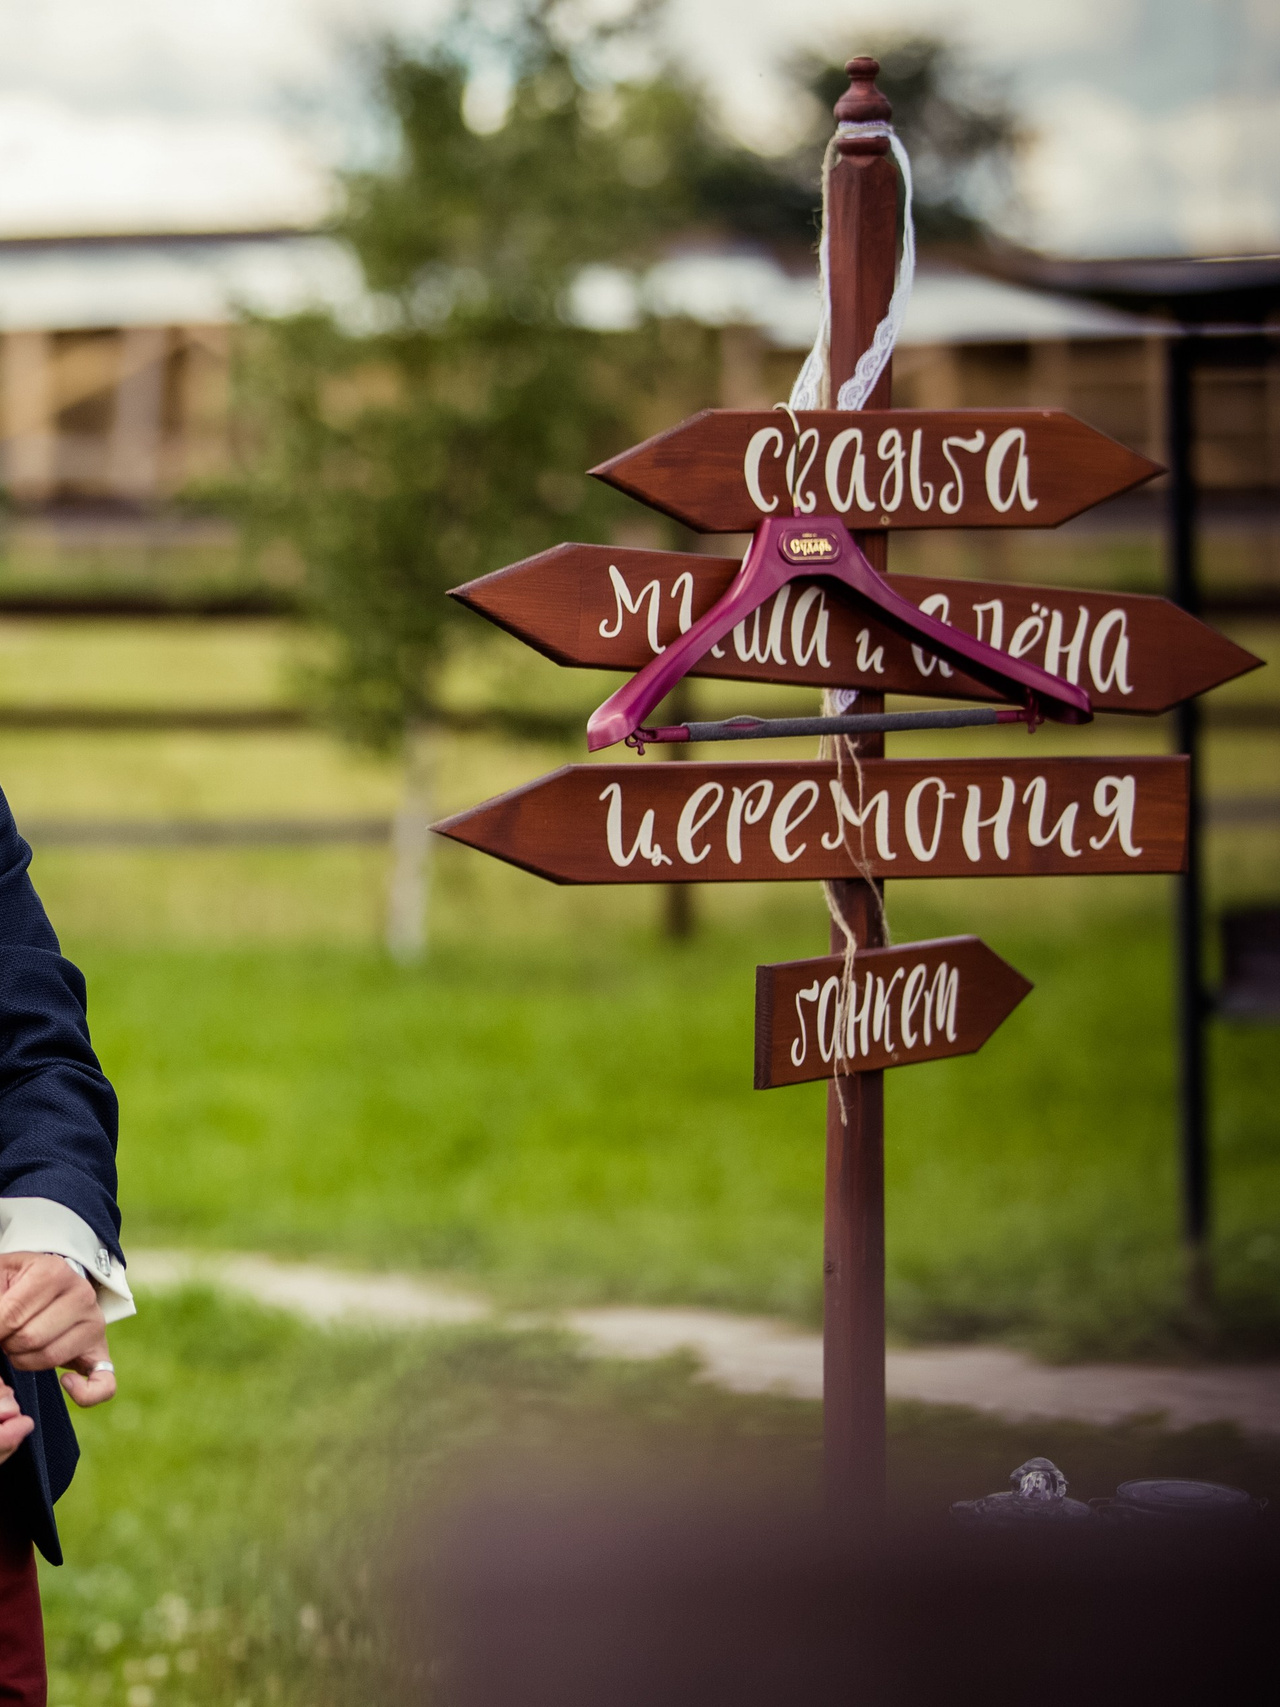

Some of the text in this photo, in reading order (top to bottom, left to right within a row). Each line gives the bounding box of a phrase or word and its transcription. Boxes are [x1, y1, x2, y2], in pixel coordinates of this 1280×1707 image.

[855, 628, 885, 674] и
[599, 776, 1143, 867] церемония
[791, 961, 959, 1067] банкет
